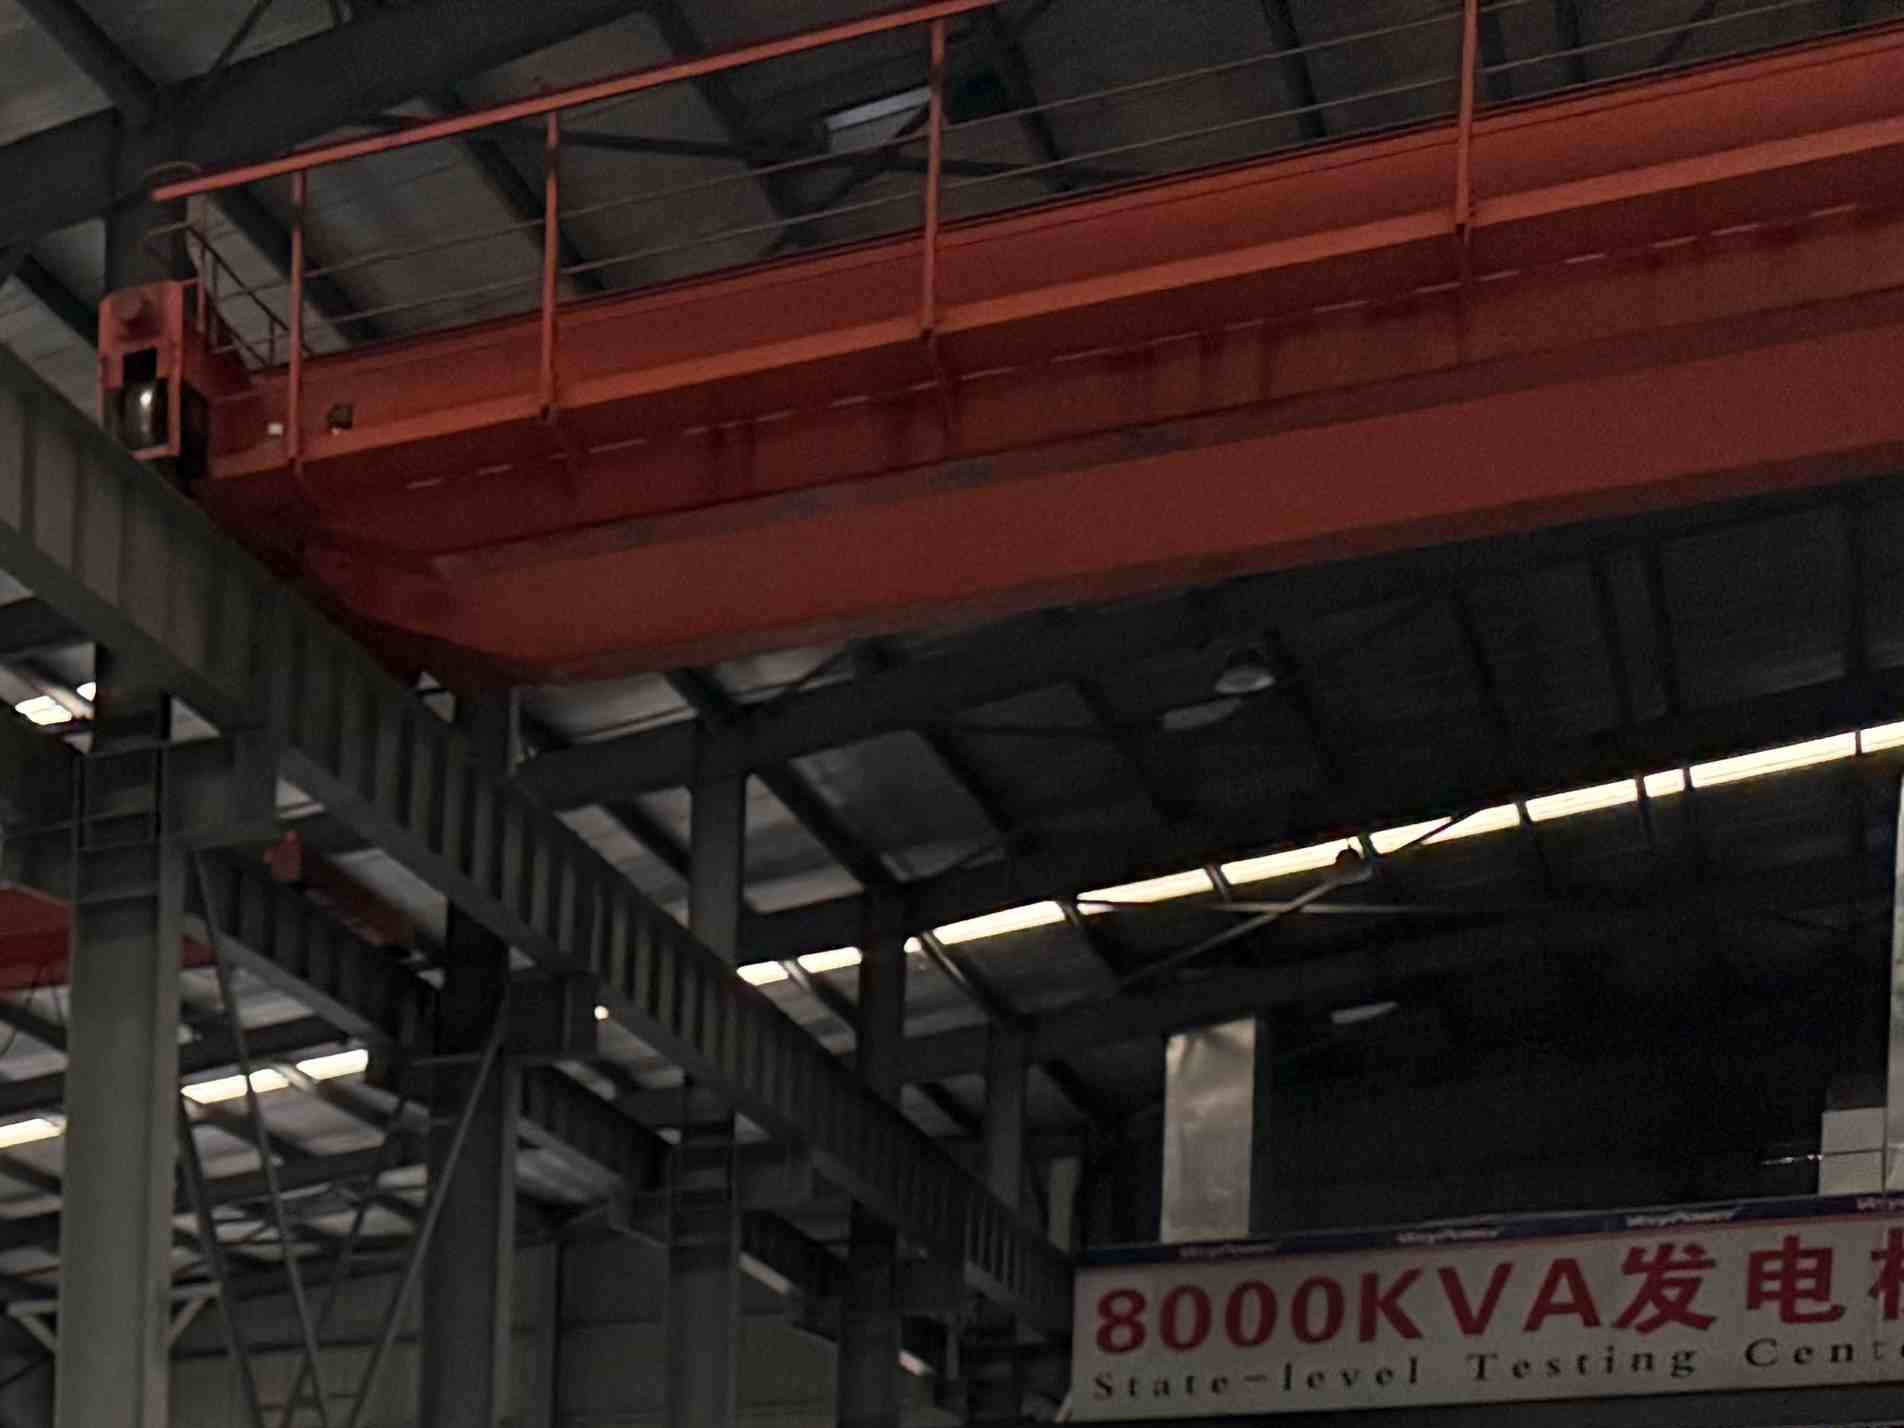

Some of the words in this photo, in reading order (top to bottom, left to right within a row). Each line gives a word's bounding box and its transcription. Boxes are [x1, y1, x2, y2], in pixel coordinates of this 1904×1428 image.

[1094, 1357, 1421, 1399] State-level
[1467, 1346, 1698, 1382] Testing
[1744, 1338, 1904, 1368] Cent
